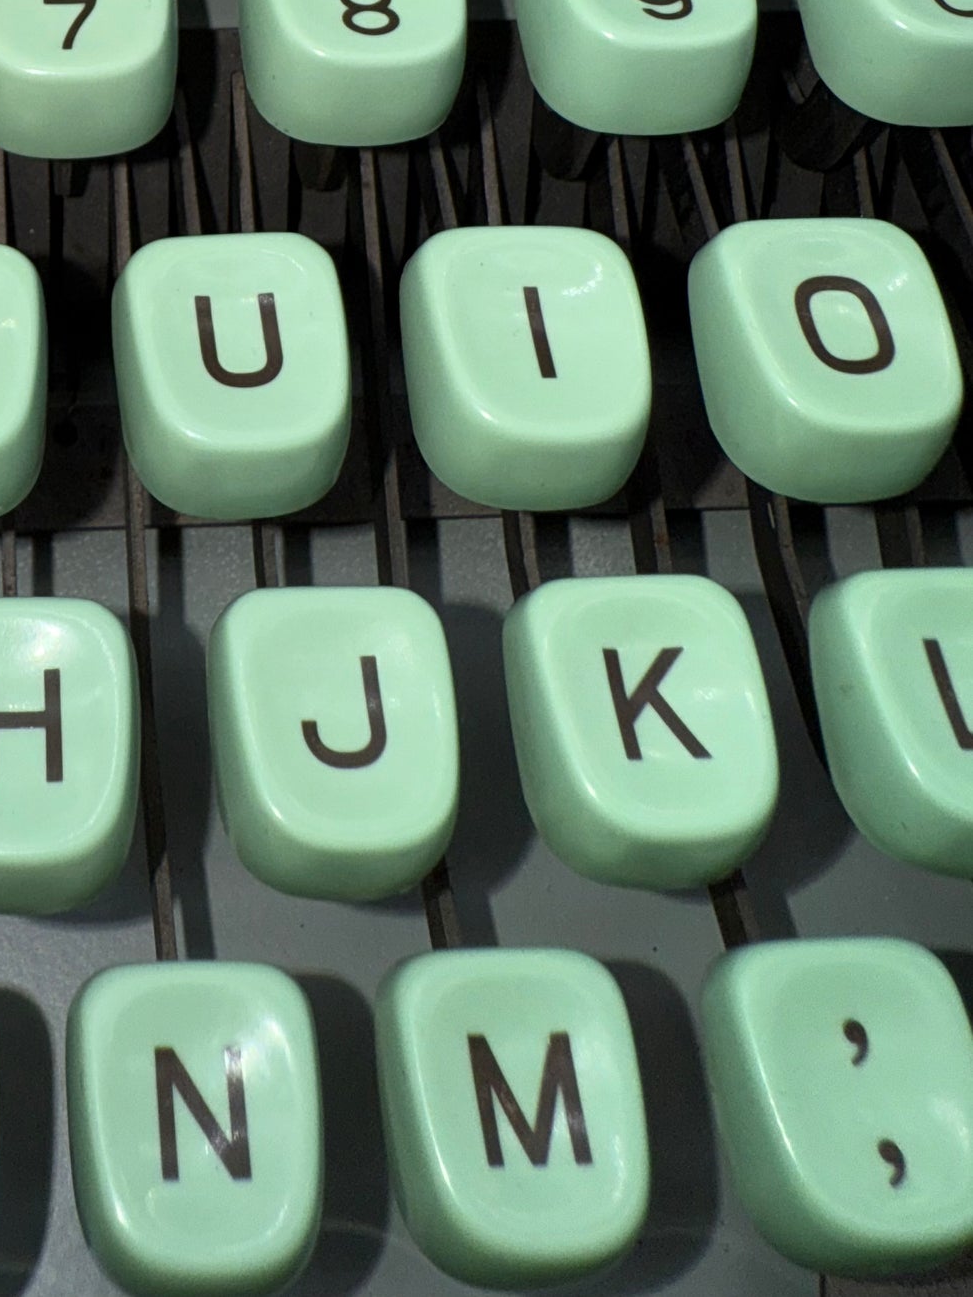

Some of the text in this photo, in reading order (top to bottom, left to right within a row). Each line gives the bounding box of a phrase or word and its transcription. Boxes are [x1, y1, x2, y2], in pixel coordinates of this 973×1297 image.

[194, 292, 284, 389] U
[523, 286, 558, 379] I
[794, 275, 896, 376] O
[300, 655, 388, 770] J
[602, 646, 712, 761] K
[154, 1046, 253, 1182] N
[466, 1031, 593, 1168] M
